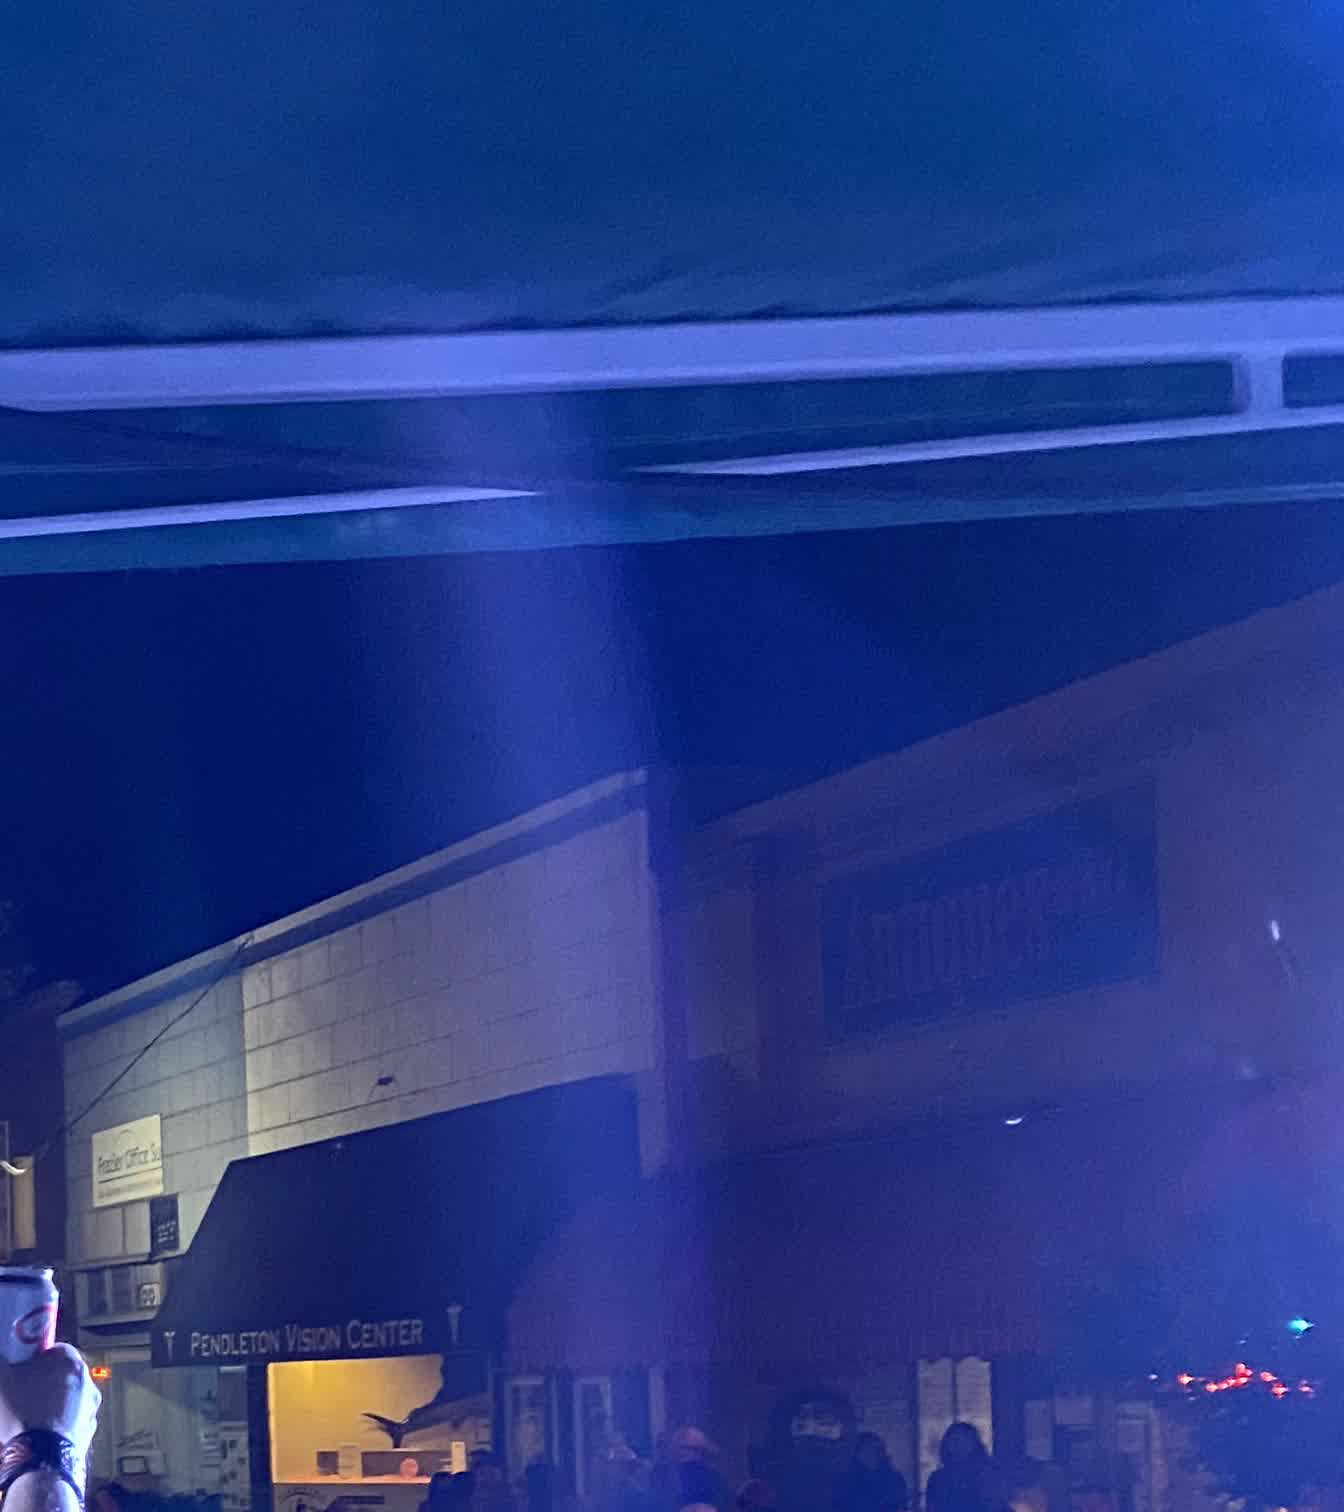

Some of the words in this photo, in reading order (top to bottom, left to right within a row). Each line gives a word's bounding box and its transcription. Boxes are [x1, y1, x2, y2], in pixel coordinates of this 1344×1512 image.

[191, 1330, 280, 1357] PENDLETON
[285, 1323, 341, 1353] VISION
[347, 1318, 424, 1350] CENTER
